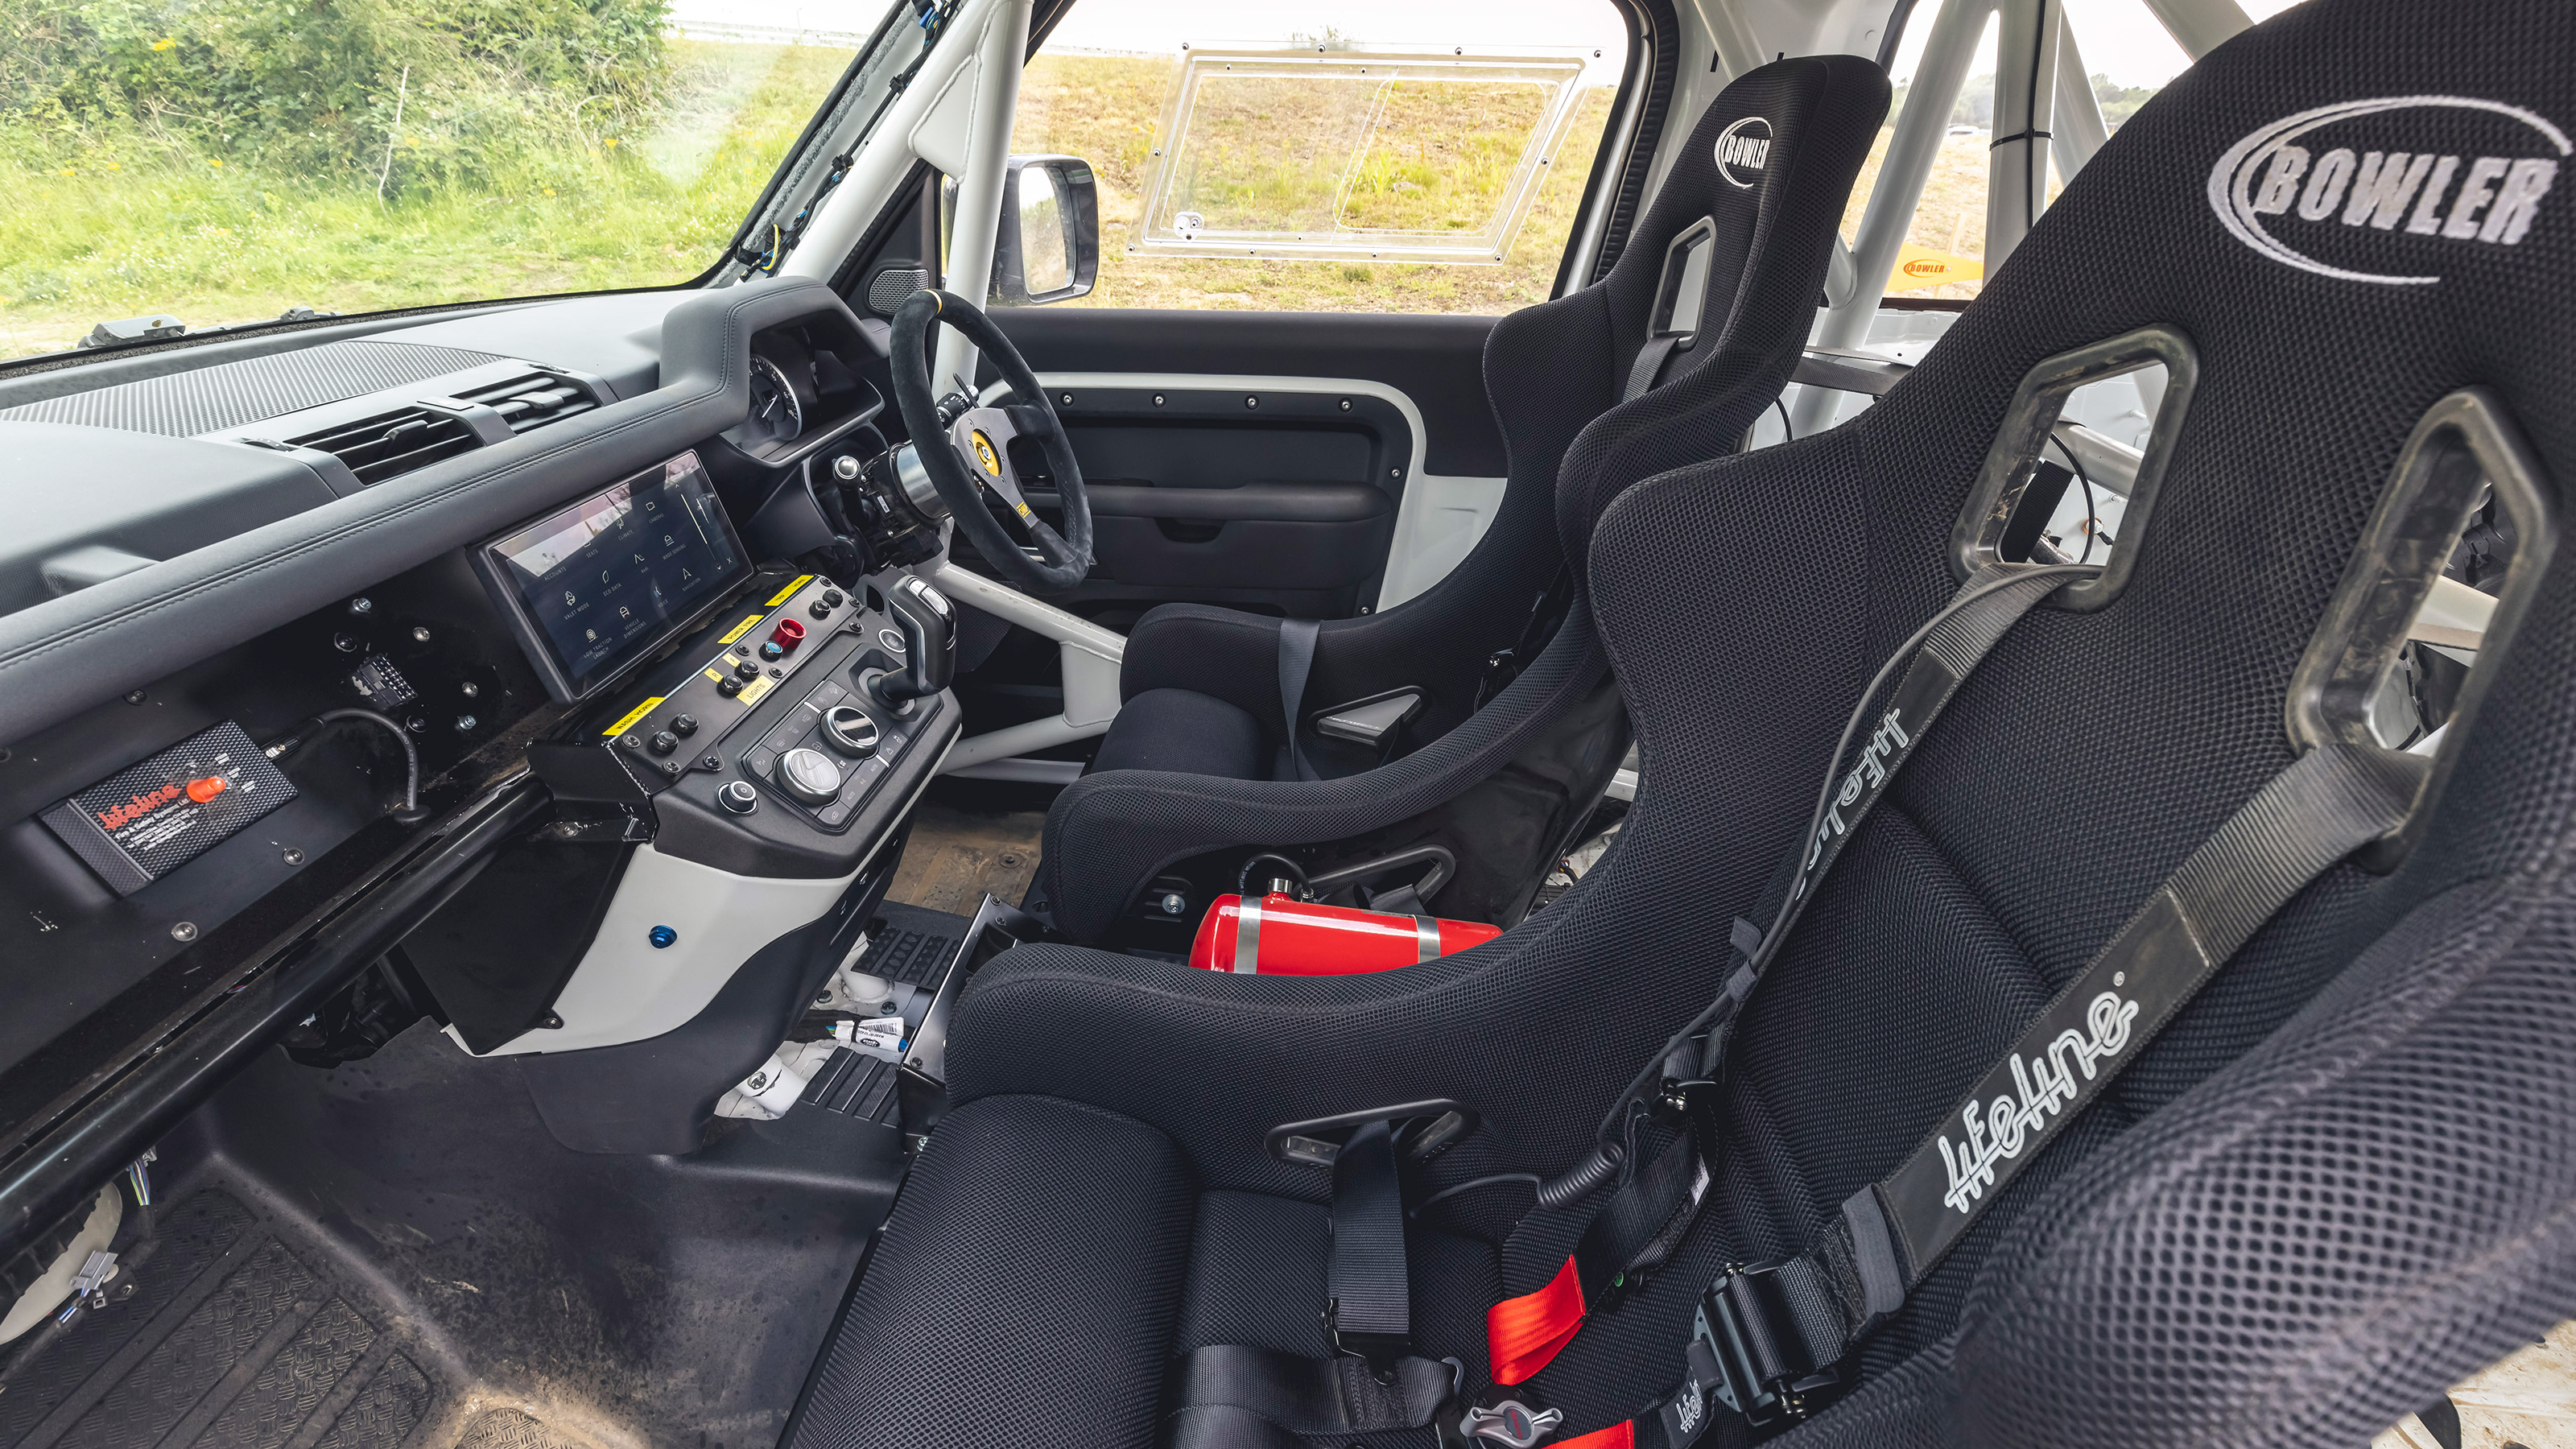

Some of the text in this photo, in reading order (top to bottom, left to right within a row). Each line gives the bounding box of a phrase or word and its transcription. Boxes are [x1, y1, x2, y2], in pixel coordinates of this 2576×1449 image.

[1724, 135, 1770, 170] BOWLER
[2255, 146, 2557, 245] BOWLER
[1910, 264, 1945, 273] BOWLER
[649, 513, 665, 523] CAMERAS
[618, 530, 634, 540] CLIMATE
[586, 549, 598, 558] SEATS
[544, 566, 567, 580] ACCOUNTS
[612, 583, 621, 592] DATA
[683, 577, 701, 592] NAVIGATION
[658, 599, 668, 608] VOICE
[564, 602, 589, 620] VALET MODE
[623, 621, 646, 638] DIMENSIONS
[625, 618, 640, 630] VEHICLE
[583, 637, 613, 658] LOW TRACTION
[593, 646, 609, 659] LAUNCH
[747, 683, 766, 699] LIGHTS
[869, 763, 878, 773] AUTO
[847, 791, 856, 800] AUTO
[115, 830, 130, 840] Fire
[134, 815, 155, 830] Safety
[154, 804, 180, 819] Systems
